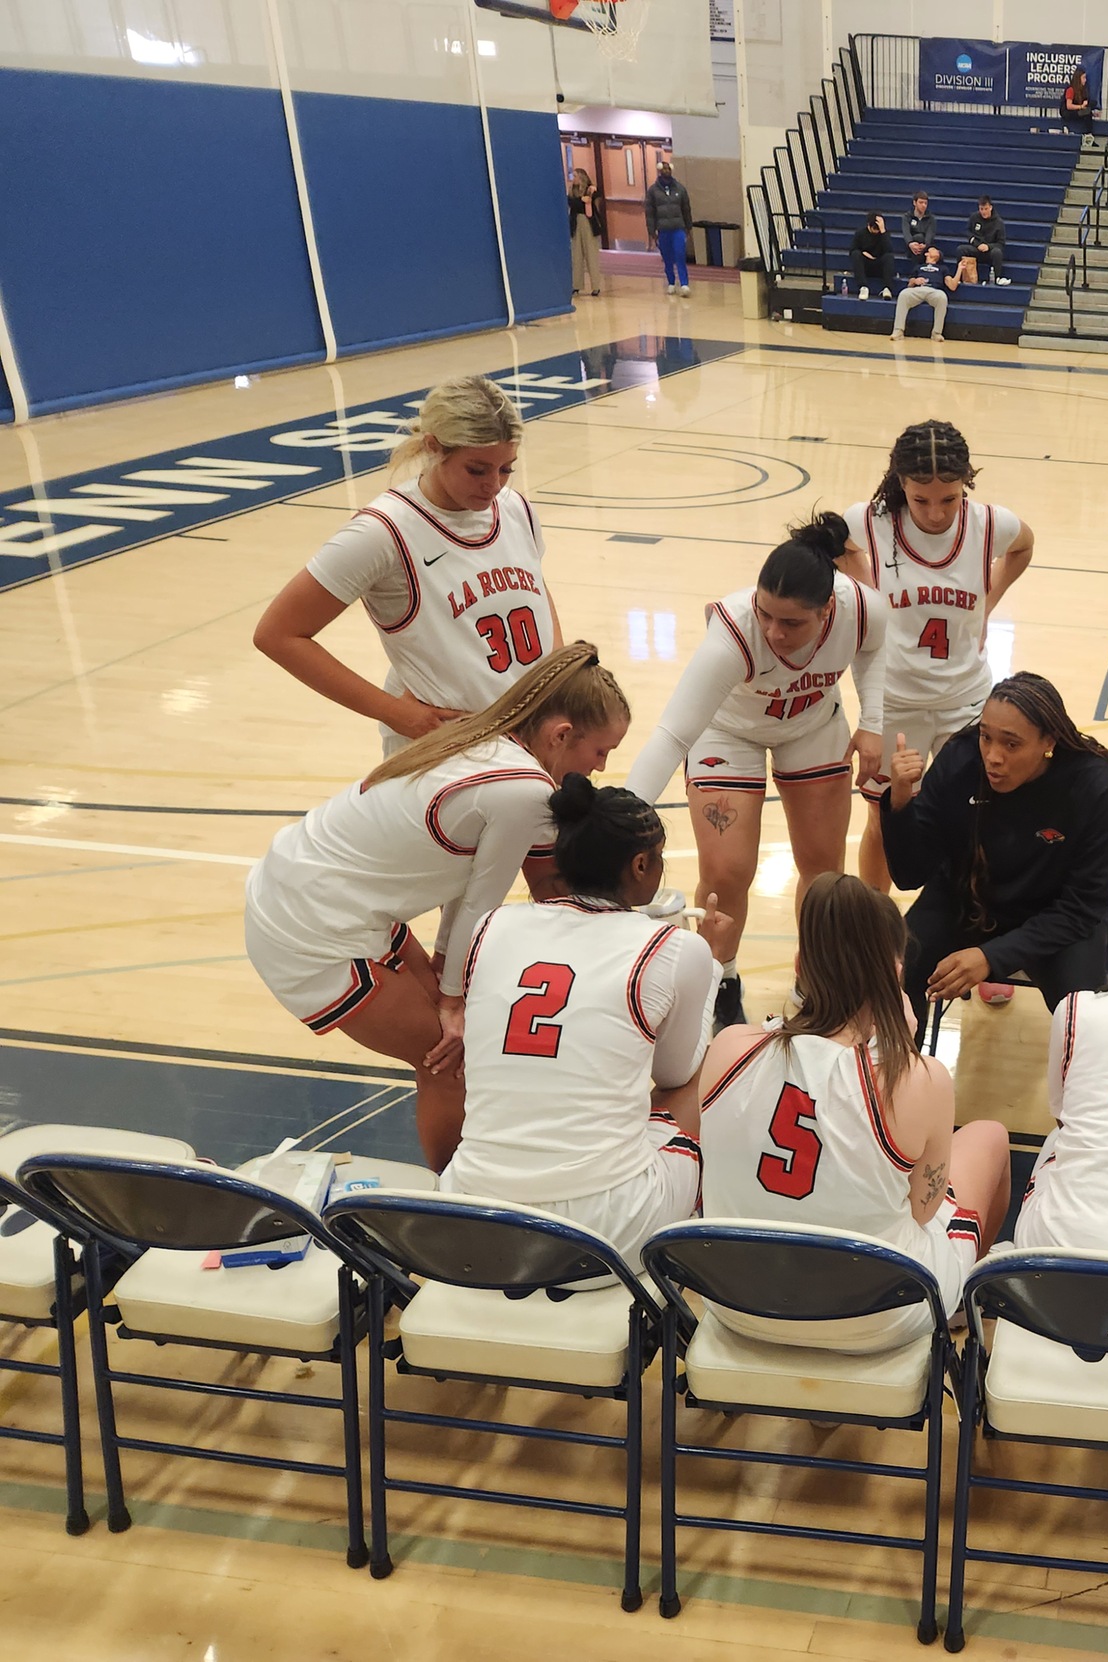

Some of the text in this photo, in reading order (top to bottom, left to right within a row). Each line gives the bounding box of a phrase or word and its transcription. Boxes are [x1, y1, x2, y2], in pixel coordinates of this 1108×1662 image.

[1026, 52, 1082, 65] INCLUSIVE
[1030, 63, 1077, 74] LEADERS
[935, 74, 993, 87] DIVISION III
[1027, 73, 1074, 84] PROGRA
[447, 566, 541, 619] LA ROCHE
[889, 586, 978, 611] LA ROCHE
[475, 605, 543, 674] 30
[918, 617, 950, 660] 4
[501, 961, 576, 1059] 2
[756, 1081, 822, 1200] 5
